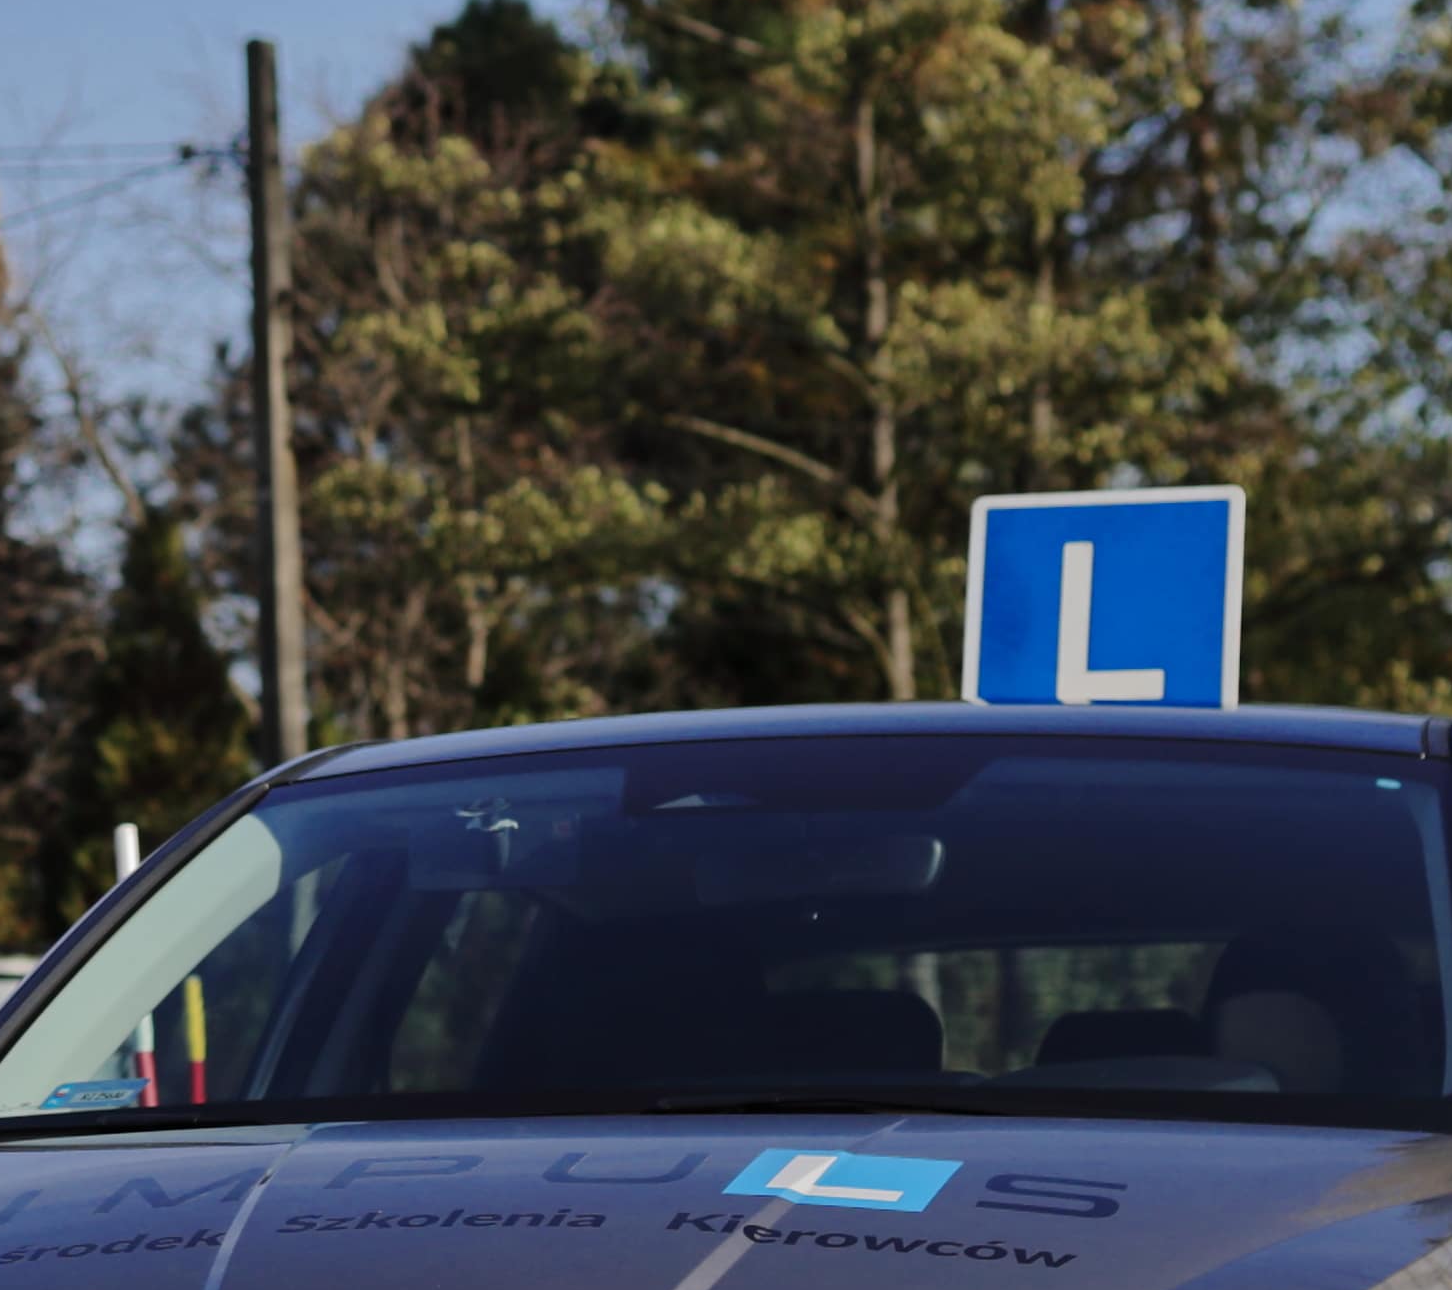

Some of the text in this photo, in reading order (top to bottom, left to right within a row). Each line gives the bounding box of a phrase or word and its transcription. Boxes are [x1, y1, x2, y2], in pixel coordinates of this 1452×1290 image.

[1056, 541, 1165, 705] L
[276, 1209, 606, 1234] Szkolenia
[666, 1212, 1078, 1268] Kierowców
